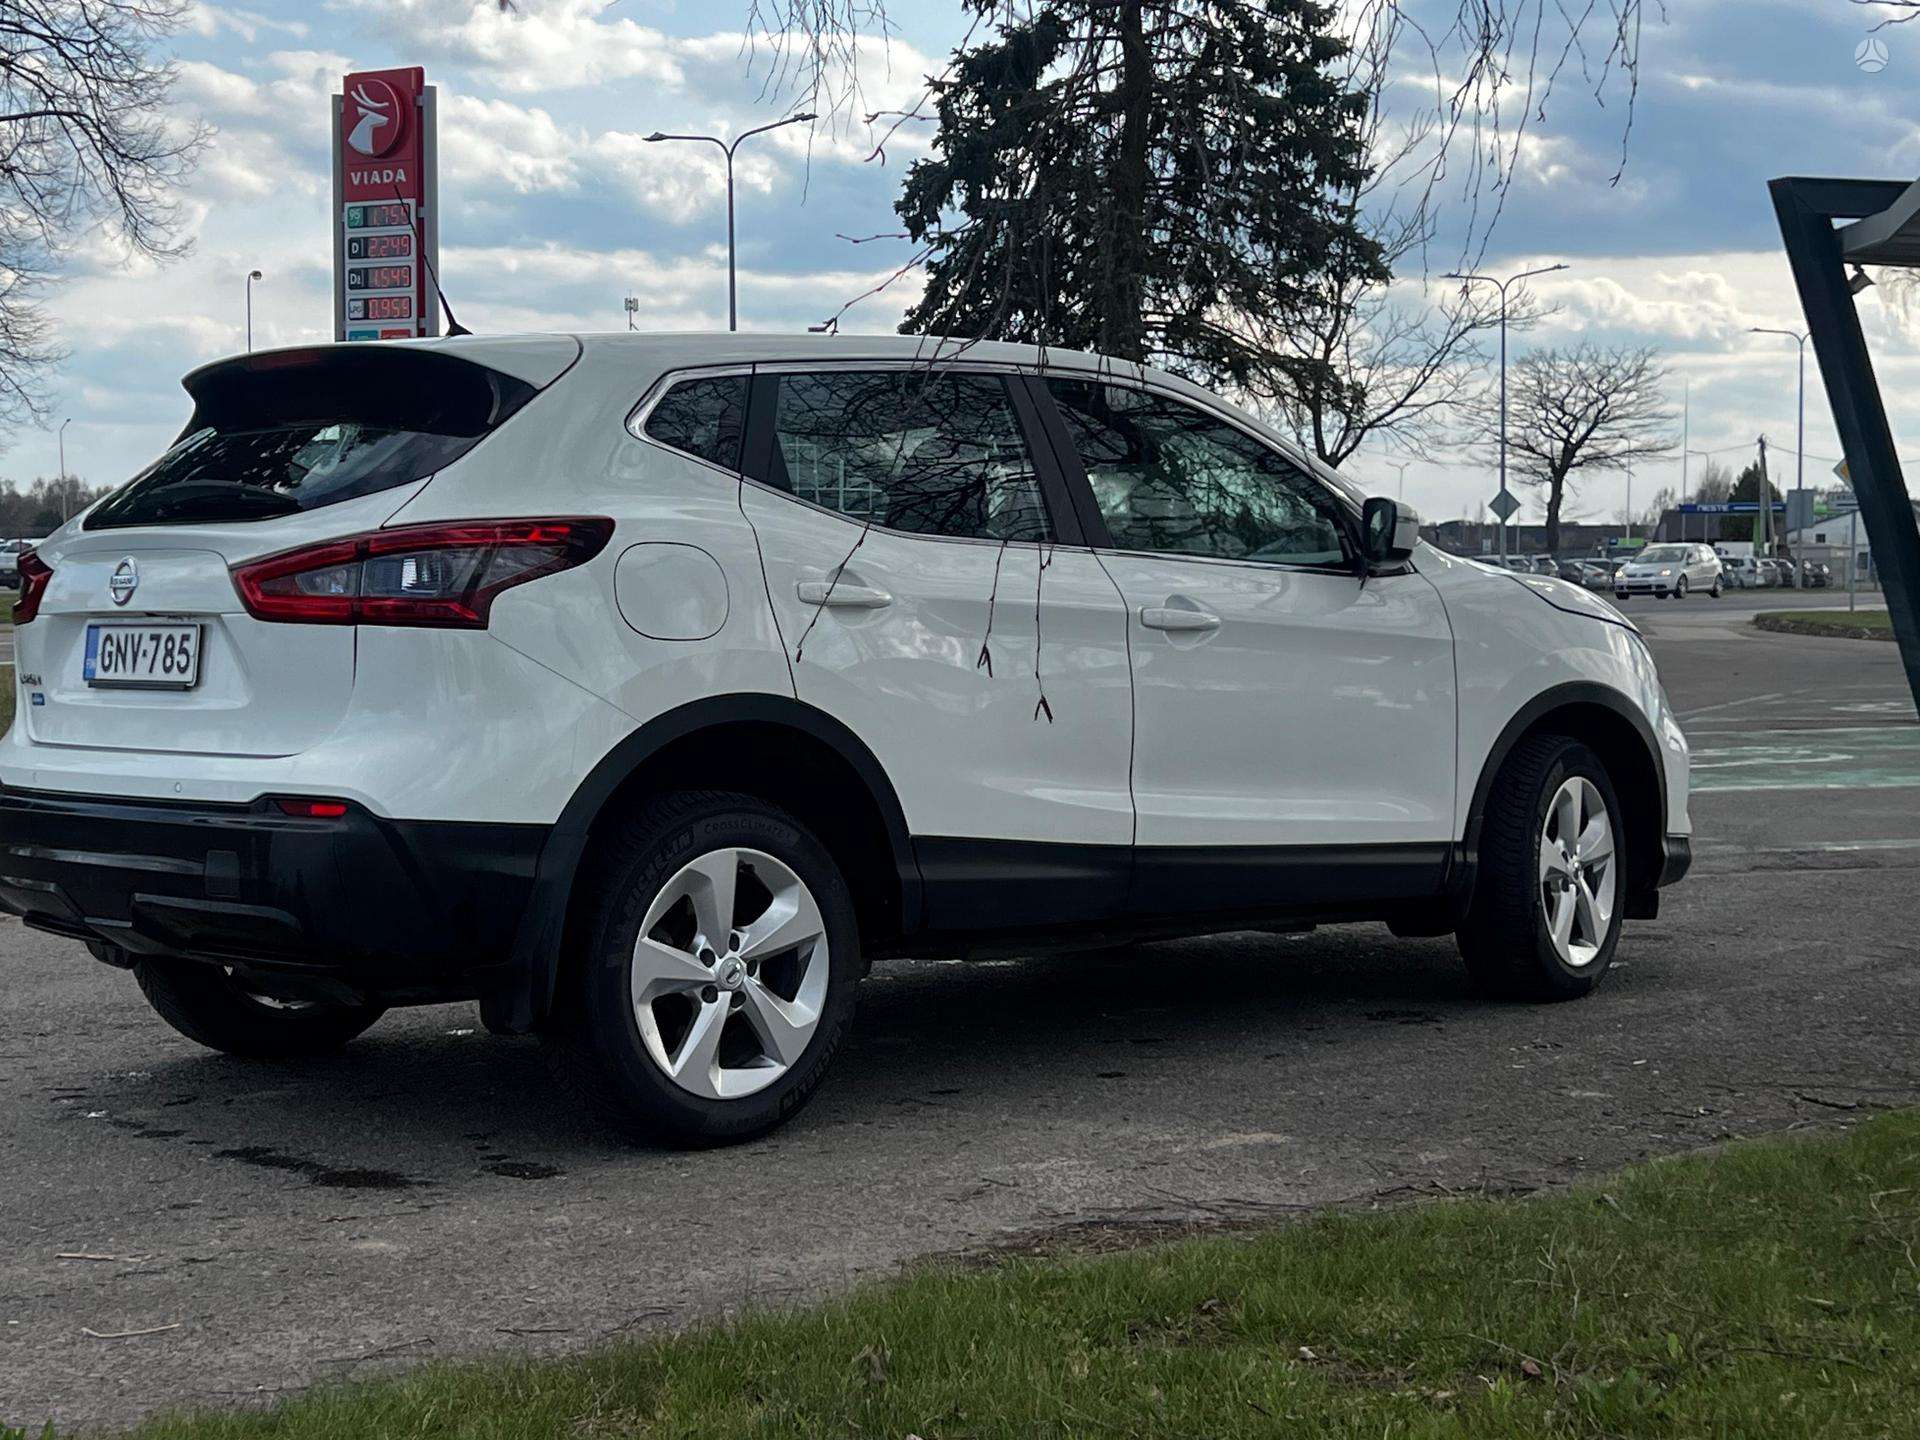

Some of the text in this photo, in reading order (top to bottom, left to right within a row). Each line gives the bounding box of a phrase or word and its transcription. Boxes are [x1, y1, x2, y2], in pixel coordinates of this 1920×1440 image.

[351, 169, 406, 185] VIADA
[352, 243, 359, 254] D
[101, 633, 191, 674] GNV-785
